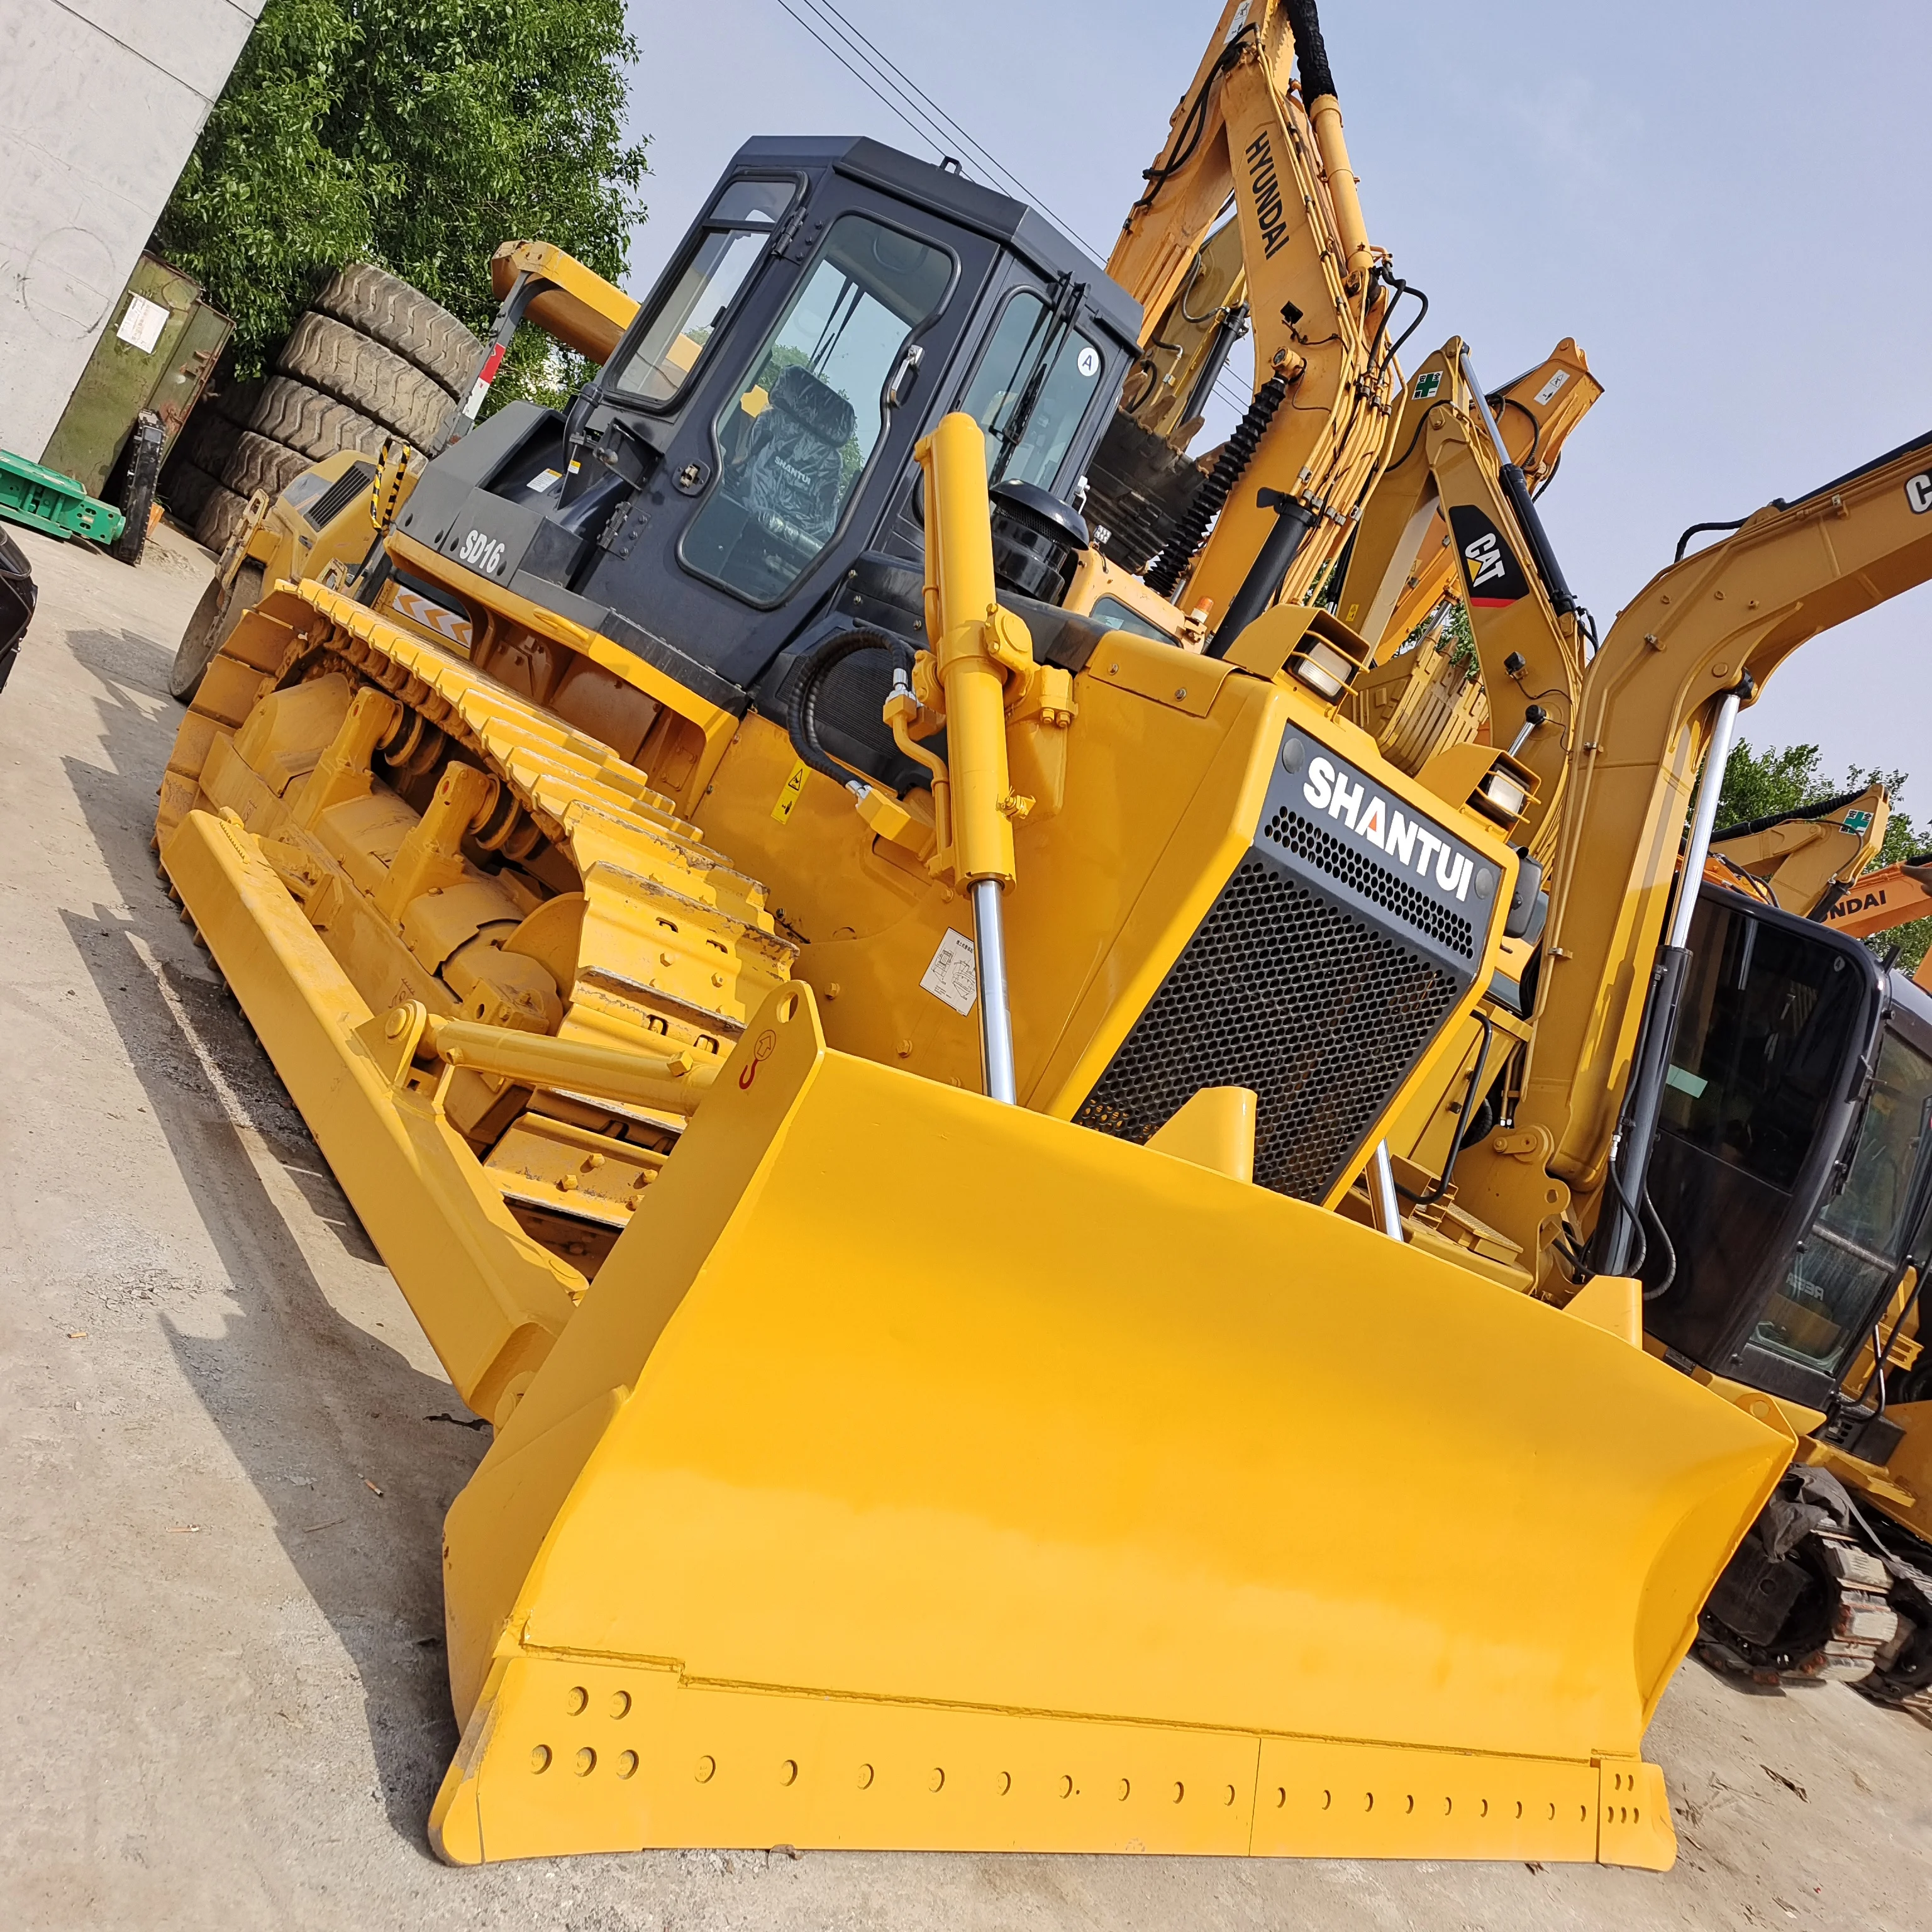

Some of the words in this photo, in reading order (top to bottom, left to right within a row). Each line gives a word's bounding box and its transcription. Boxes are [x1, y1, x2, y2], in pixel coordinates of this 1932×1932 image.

[1245, 130, 1290, 260] HYUNDAI
[1081, 354, 1092, 371] A
[774, 456, 811, 485] SHANTUI
[459, 530, 505, 573] SD16
[1465, 533, 1506, 587] CAT
[1303, 757, 1474, 902] SHANTUI
[1823, 890, 1887, 922] NDAI
